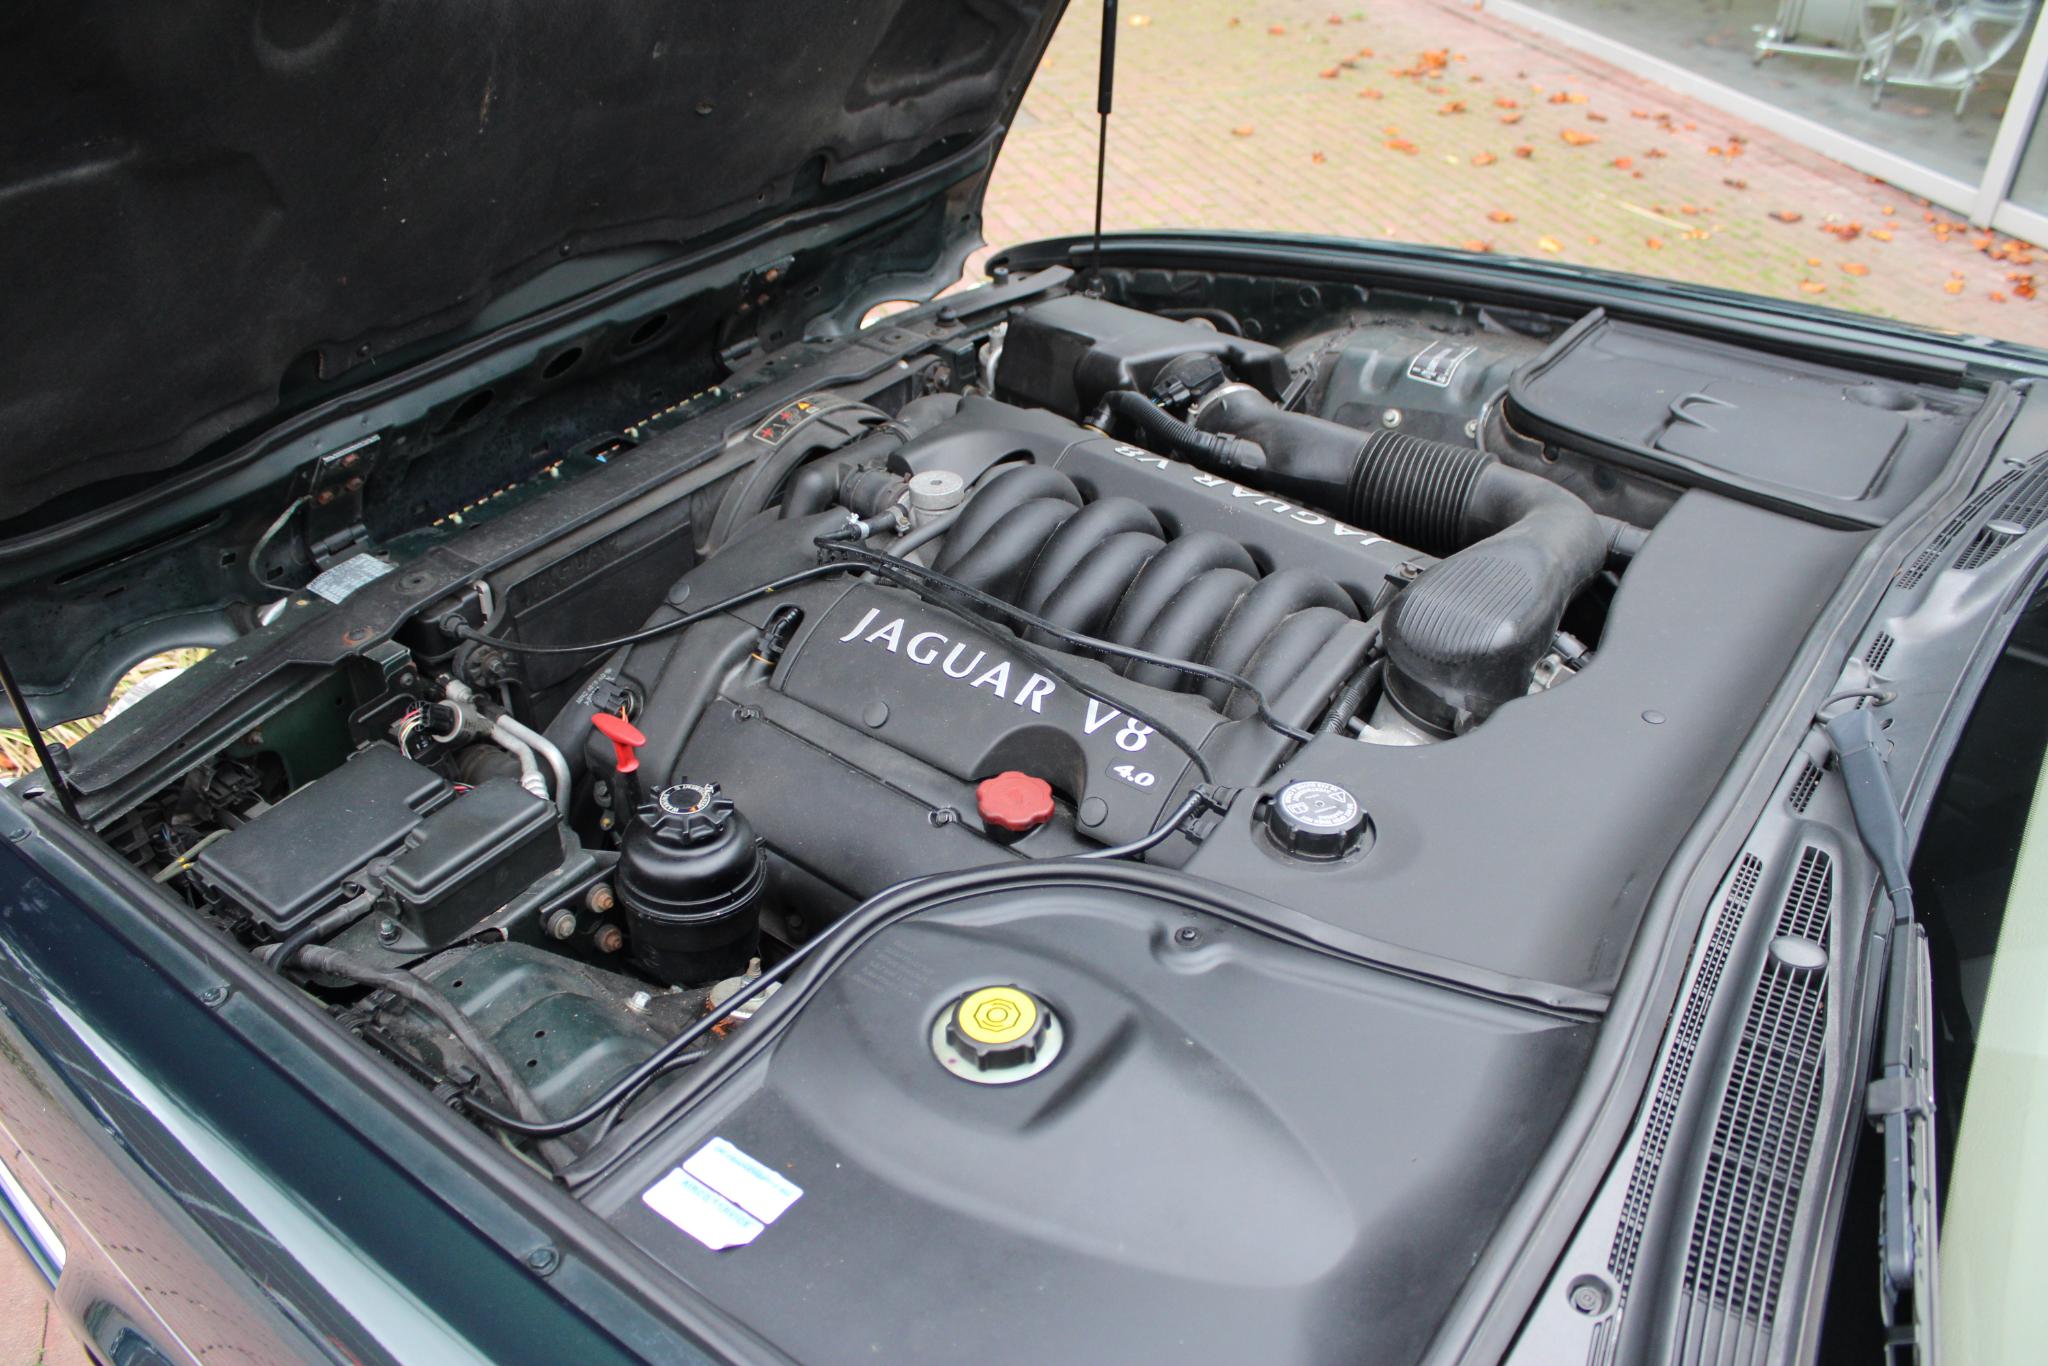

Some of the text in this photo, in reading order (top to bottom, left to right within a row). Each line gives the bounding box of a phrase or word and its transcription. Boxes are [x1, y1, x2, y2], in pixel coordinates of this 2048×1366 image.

[1113, 445, 1391, 547] JAGUAR V8
[839, 607, 1056, 714] JAGUAR
[1082, 697, 1155, 752] V8
[1112, 764, 1155, 787] 4.0
